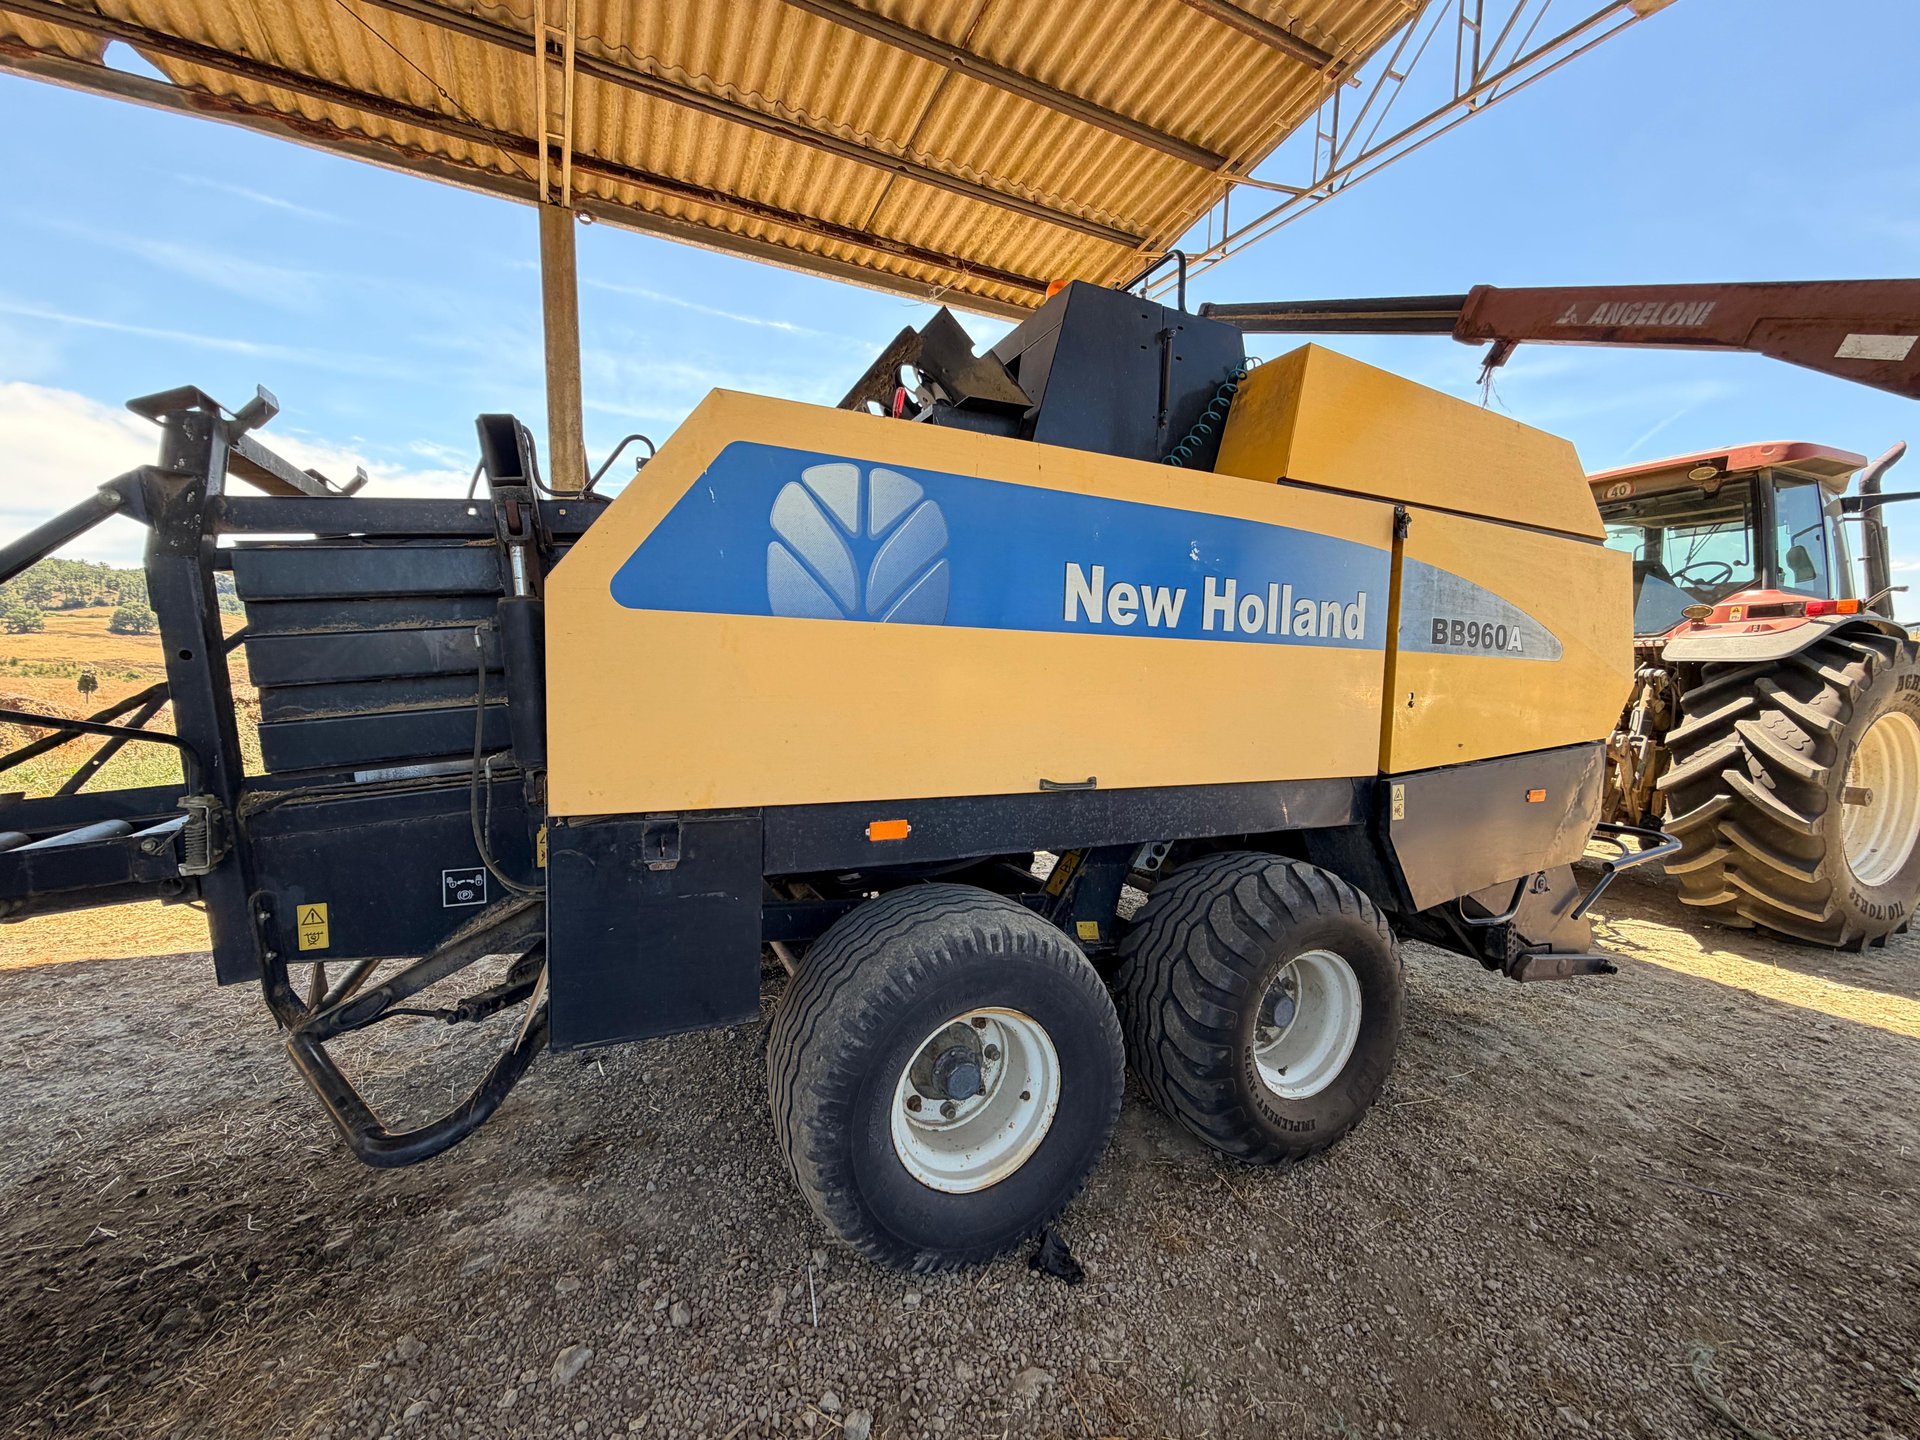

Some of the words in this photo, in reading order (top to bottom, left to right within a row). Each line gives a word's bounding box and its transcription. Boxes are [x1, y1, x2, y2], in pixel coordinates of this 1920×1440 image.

[1587, 301, 1716, 326] ANGELONI
[1611, 485, 1627, 498] 40
[1063, 561, 1186, 629] New
[1202, 575, 1367, 641] Holland
[1431, 617, 1523, 653] BB960A
[1894, 673, 1920, 693] AGR
[1256, 1099, 1316, 1132] IMPLEMENT
